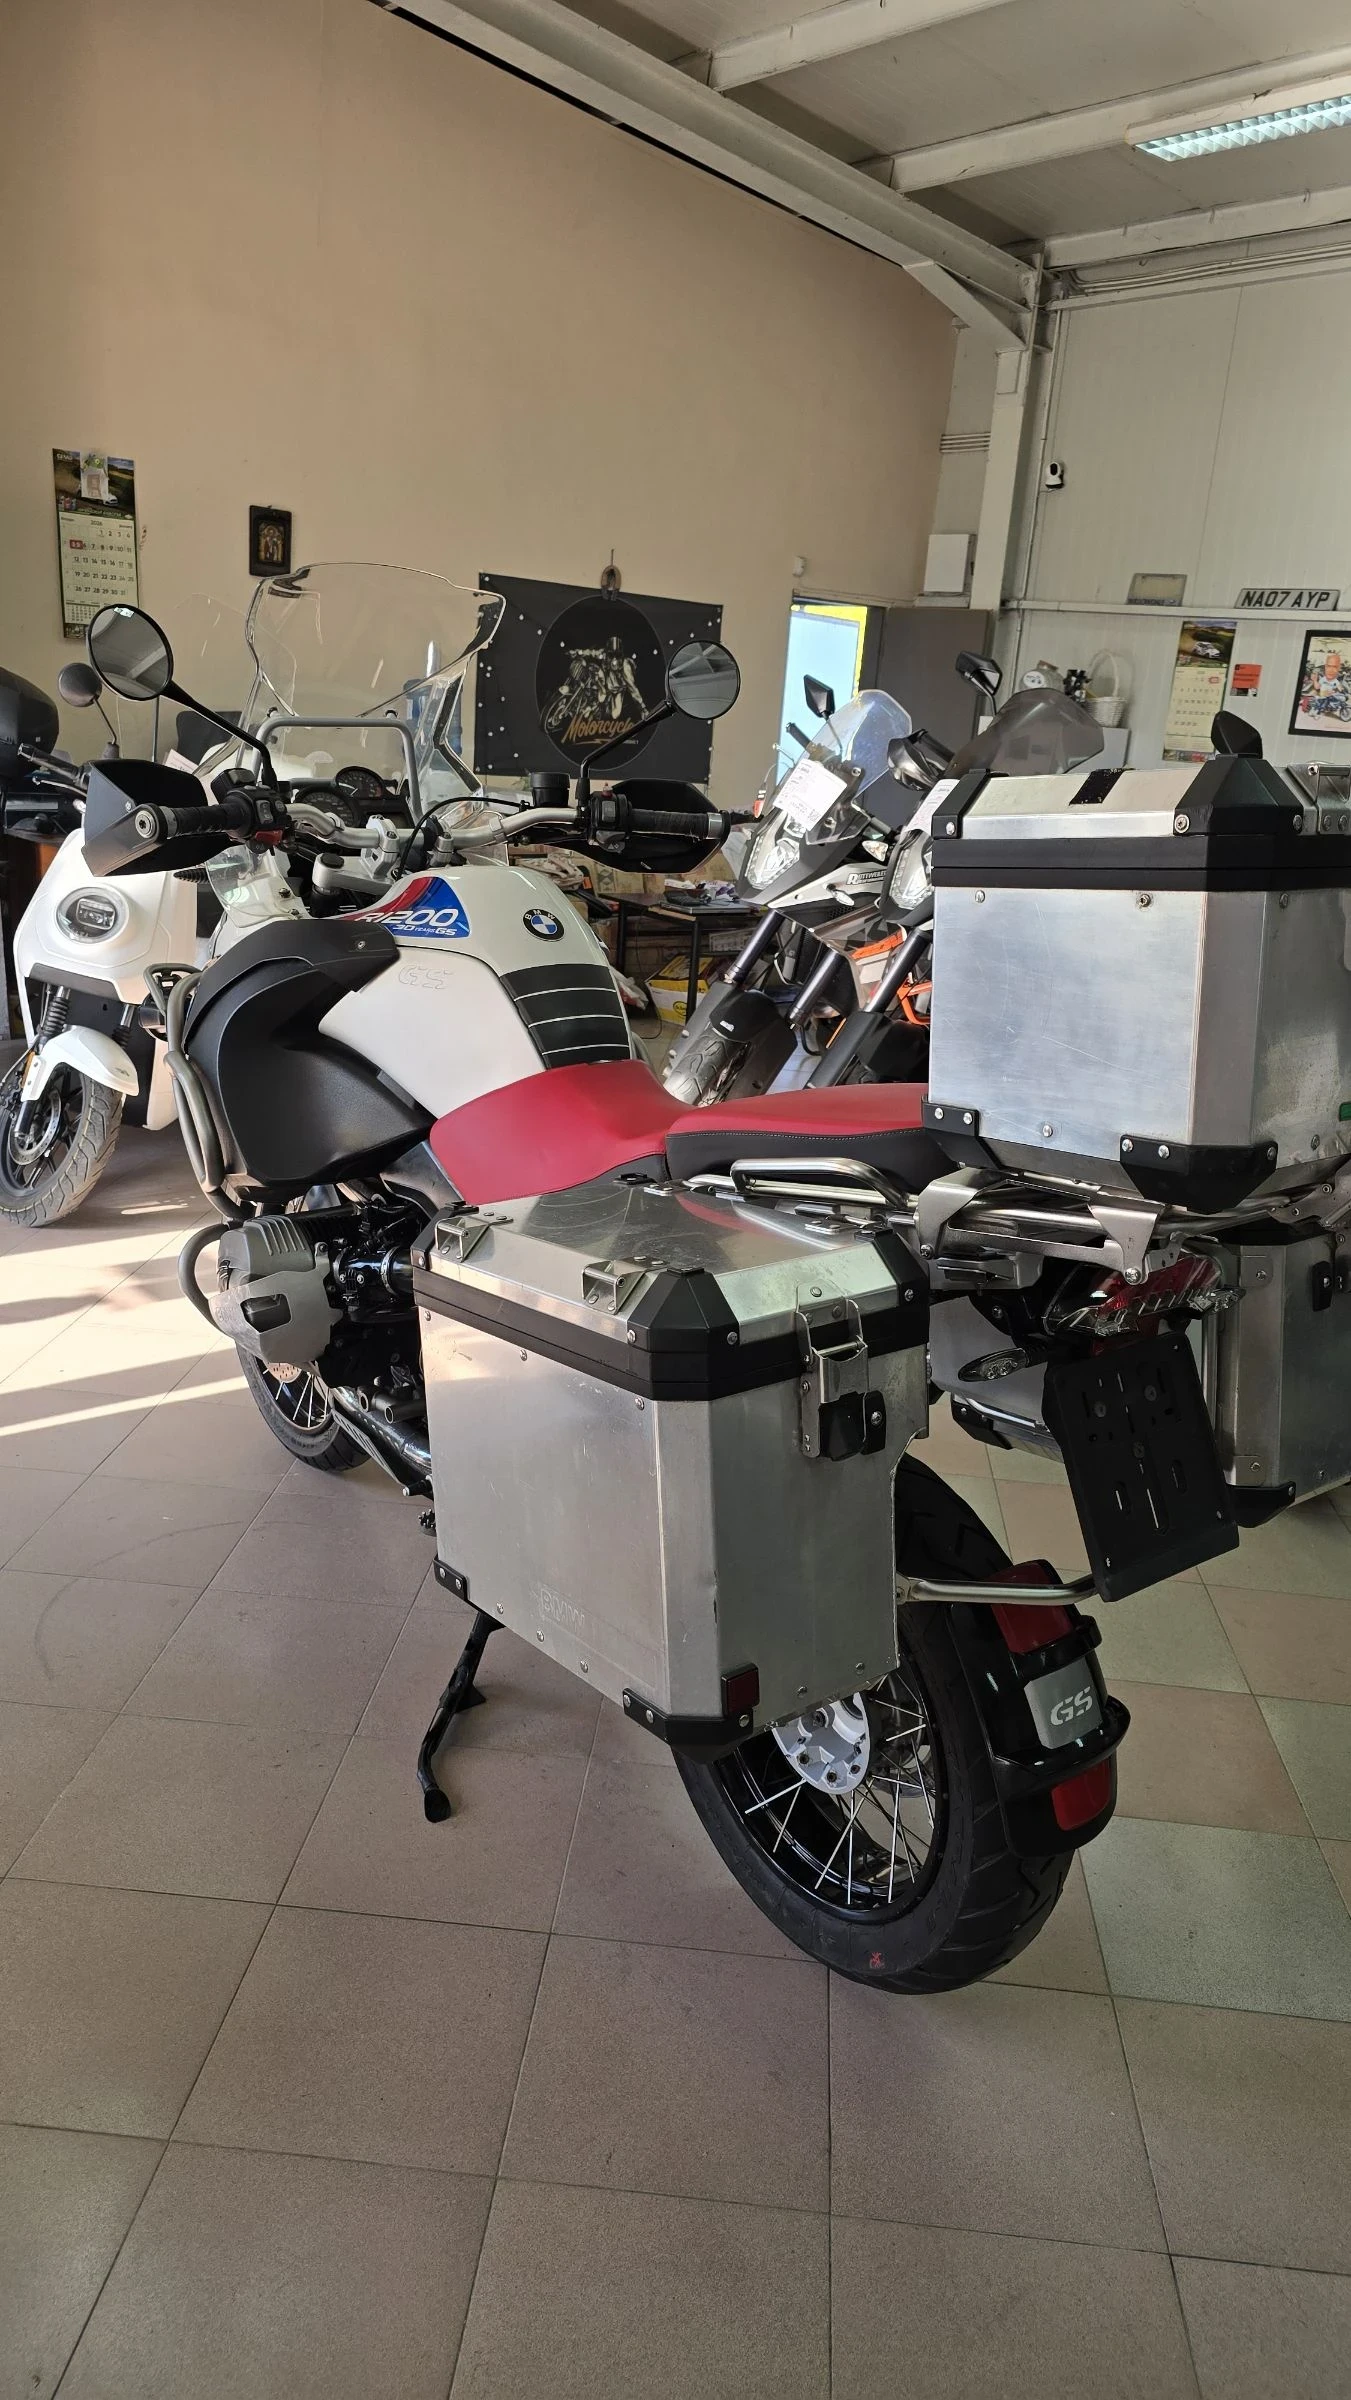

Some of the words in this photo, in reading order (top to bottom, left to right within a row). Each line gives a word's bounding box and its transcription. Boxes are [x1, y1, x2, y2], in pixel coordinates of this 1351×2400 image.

[1241, 591, 1291, 607] NA07
[1291, 592, 1330, 608] AYP
[354, 908, 459, 927] R1200
[435, 927, 458, 936] GS
[398, 964, 453, 989] GS
[540, 1588, 585, 1631] BMW
[1050, 1686, 1093, 1726] GS
